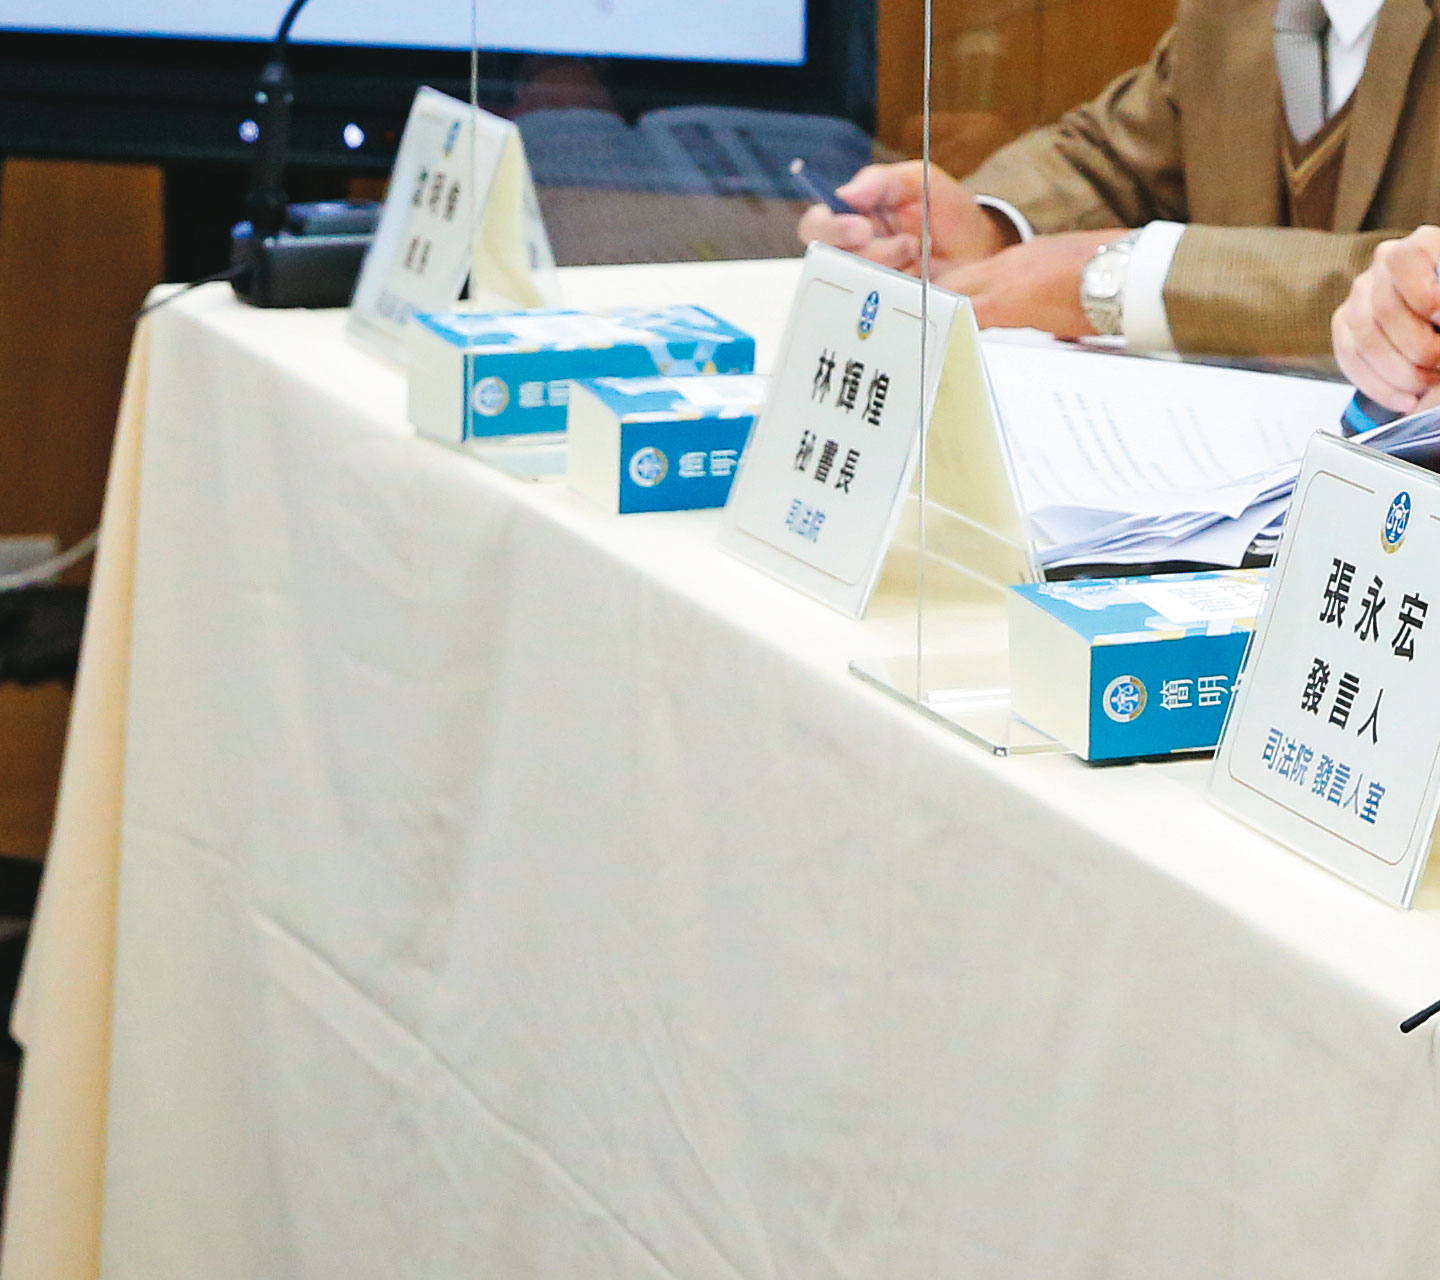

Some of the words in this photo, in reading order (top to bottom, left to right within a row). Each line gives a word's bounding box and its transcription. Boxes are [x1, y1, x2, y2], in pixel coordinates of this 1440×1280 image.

[1319, 557, 1429, 662] 張永宏
[1159, 675, 1242, 711] 簡明
[1300, 657, 1385, 745] 發言人
[1262, 727, 1314, 786] 司法院
[1311, 753, 1386, 824] 發言人室
